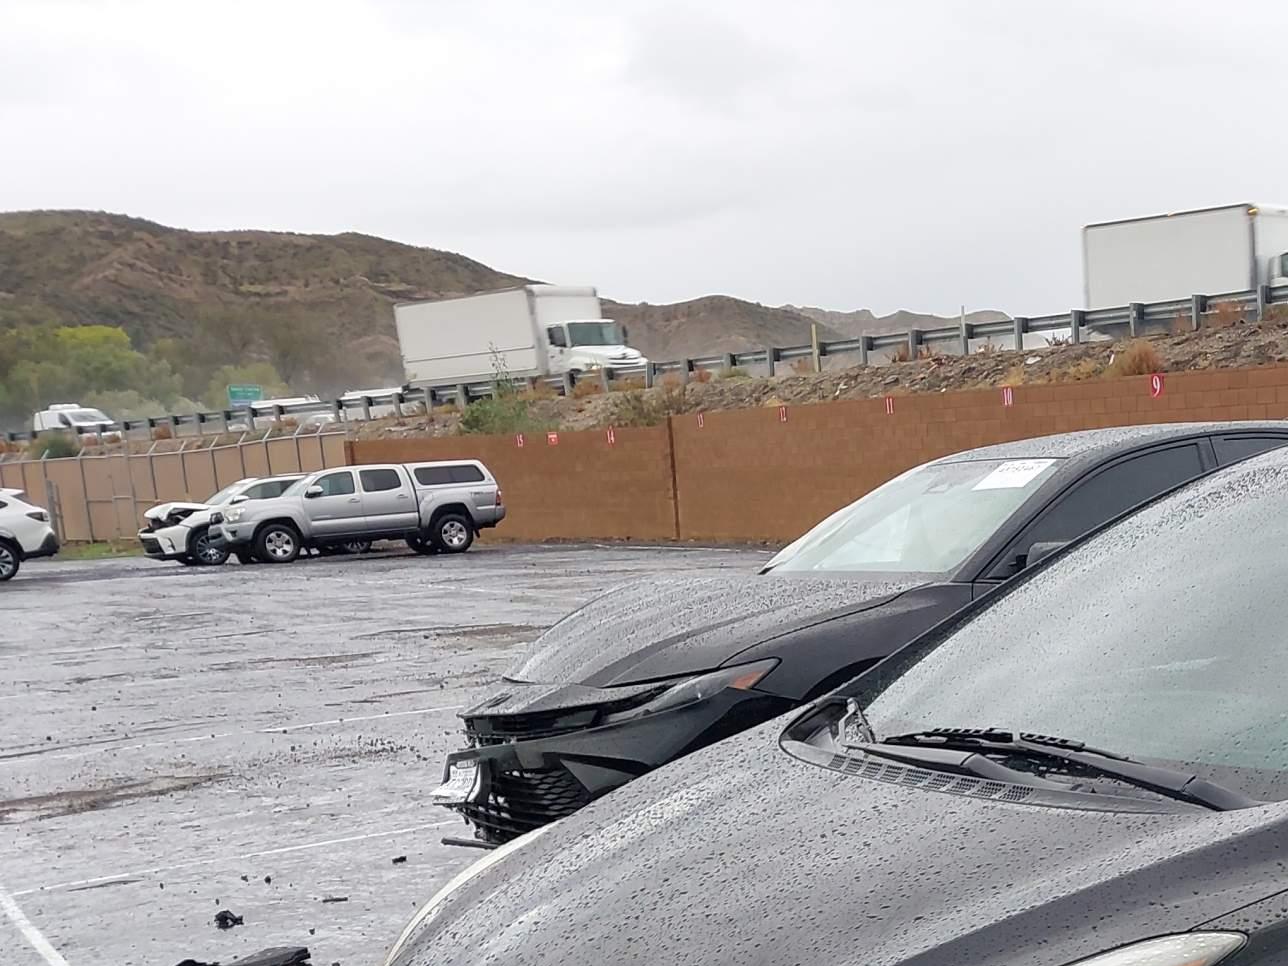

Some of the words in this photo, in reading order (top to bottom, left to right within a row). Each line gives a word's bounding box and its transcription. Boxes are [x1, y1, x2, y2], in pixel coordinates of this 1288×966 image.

[1152, 375, 1161, 398] 9
[886, 397, 894, 415] 11
[1003, 387, 1013, 407] 10
